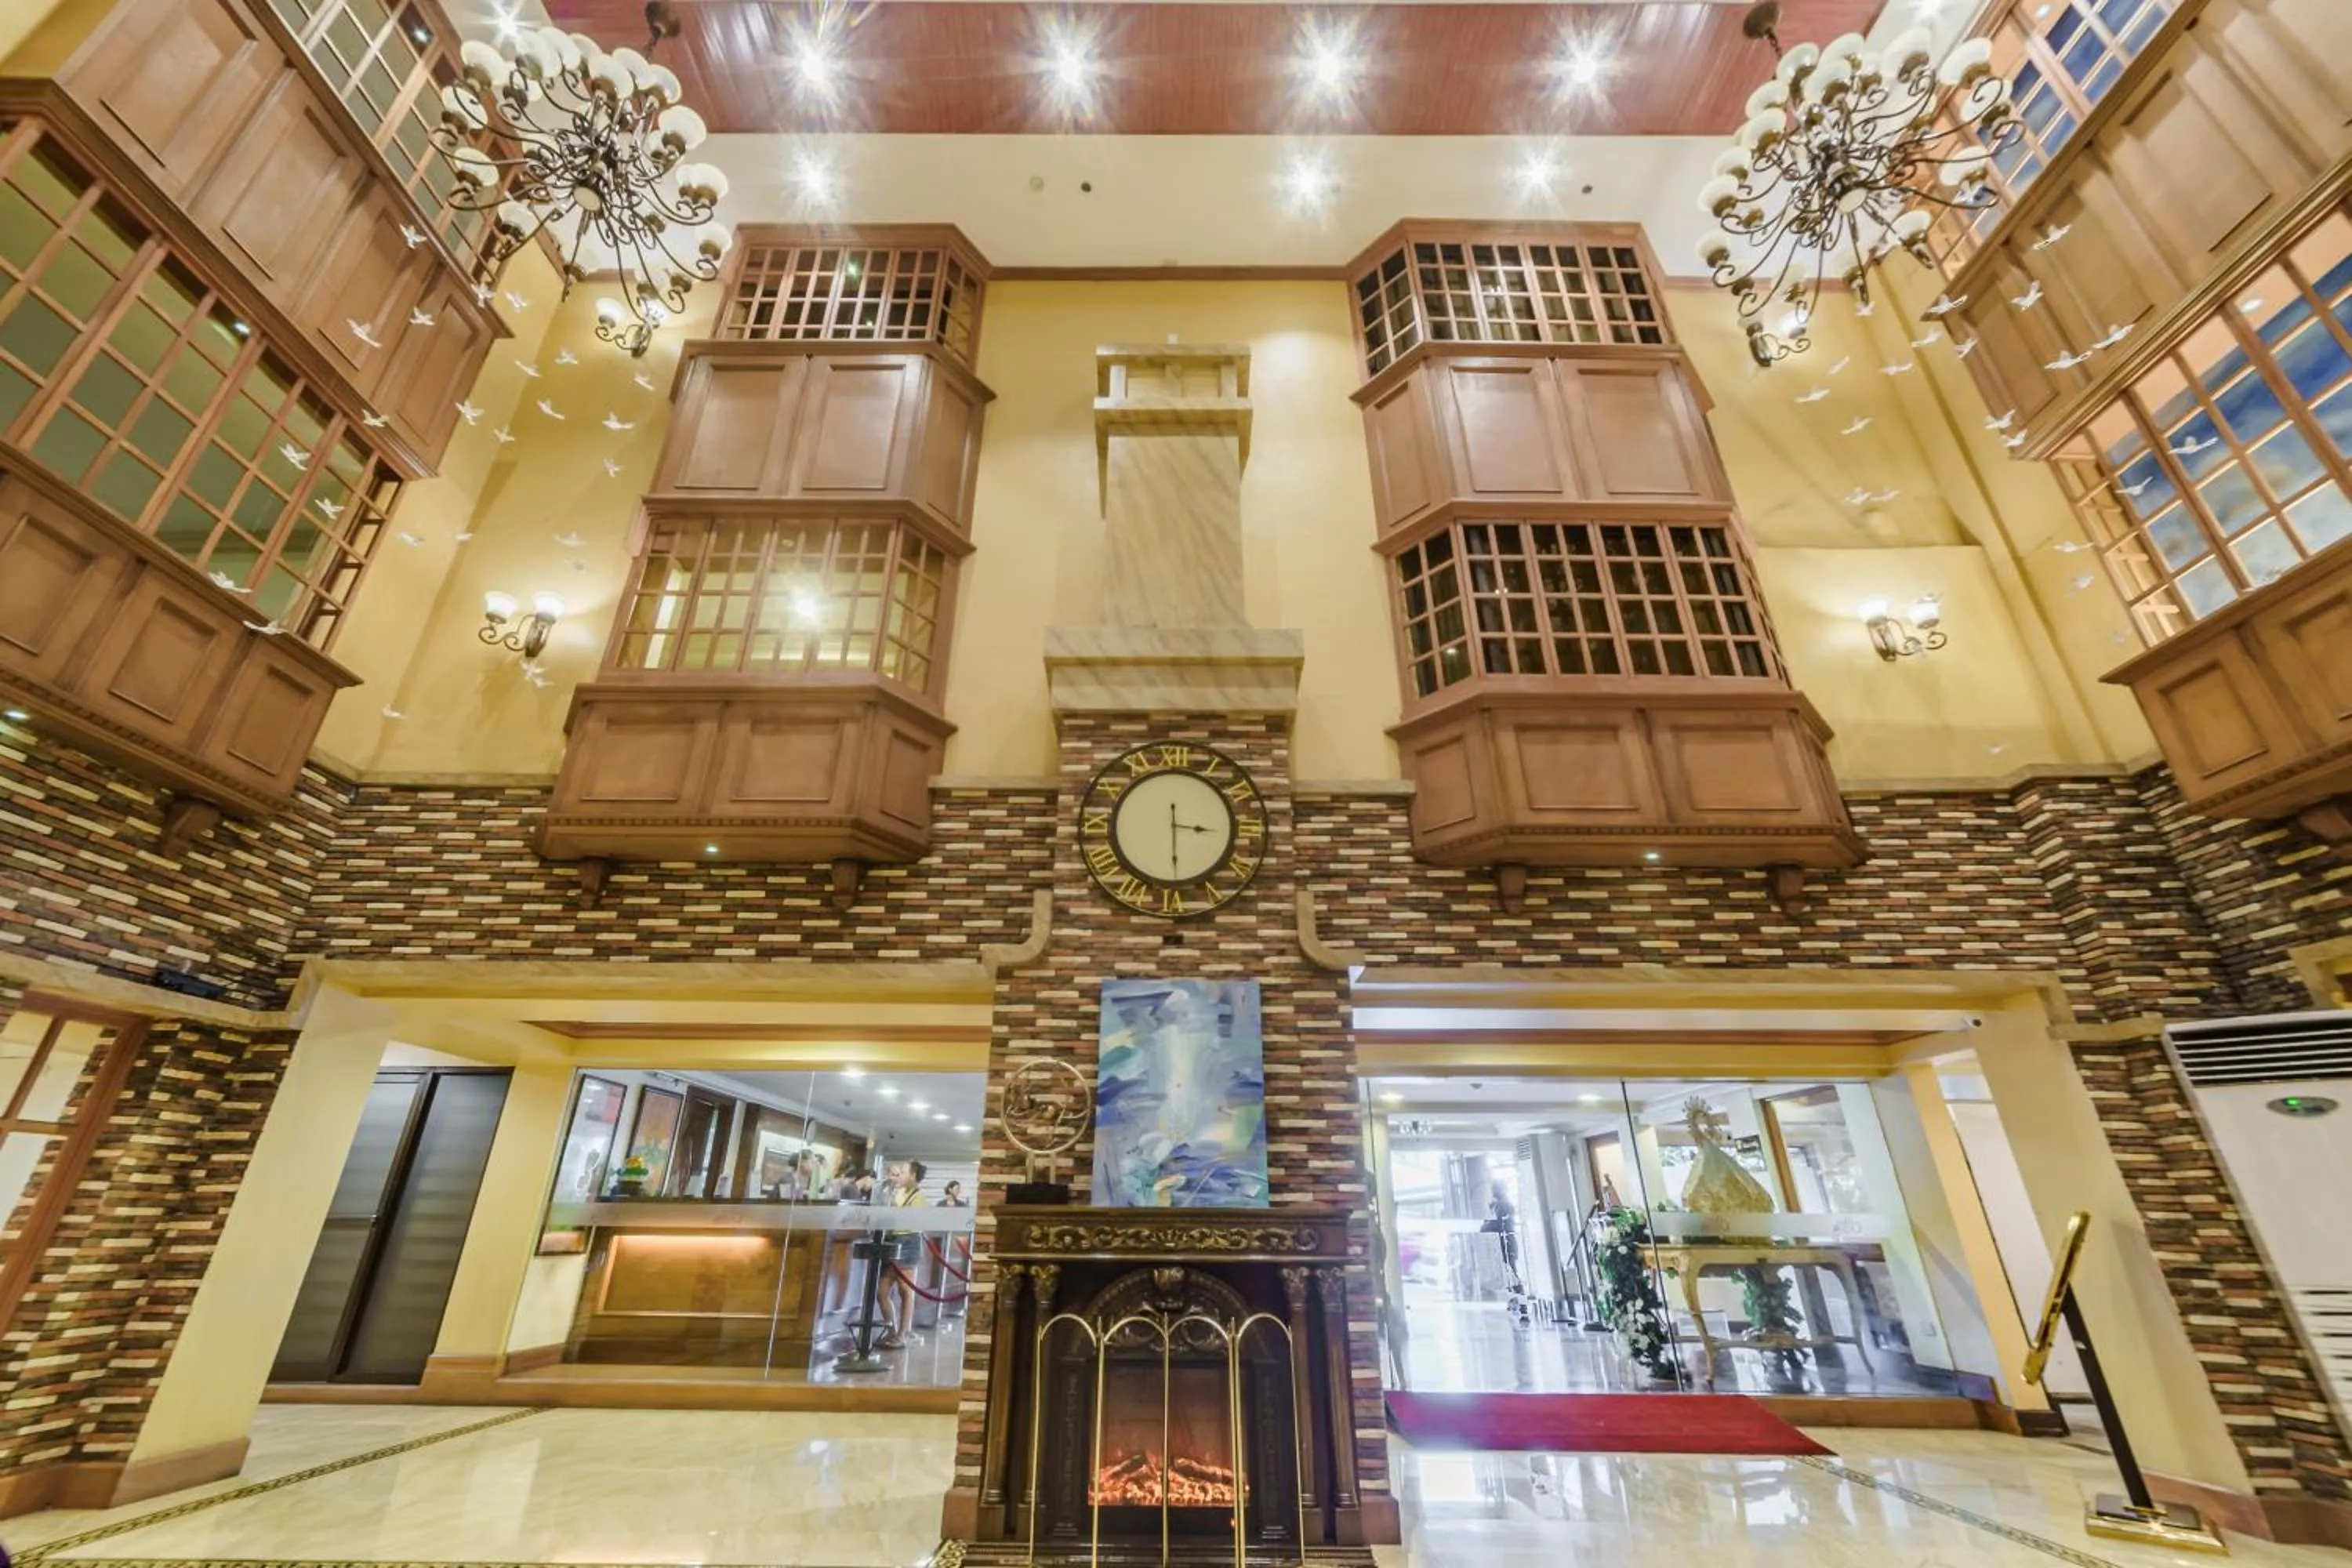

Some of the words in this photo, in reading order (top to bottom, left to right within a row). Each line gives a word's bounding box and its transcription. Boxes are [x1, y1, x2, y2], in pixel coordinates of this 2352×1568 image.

[1123, 751, 1154, 777] XI
[1159, 746, 1189, 767] XII
[1201, 757, 1220, 775] I
[1097, 778, 1121, 800] X
[1223, 779, 1253, 803] II
[1084, 811, 1108, 834] IX
[1239, 818, 1262, 837] III
[1088, 840, 1120, 880] VIII
[1116, 874, 1147, 906] VII
[1162, 889, 1185, 913] VI
[1204, 881, 1223, 908] V
